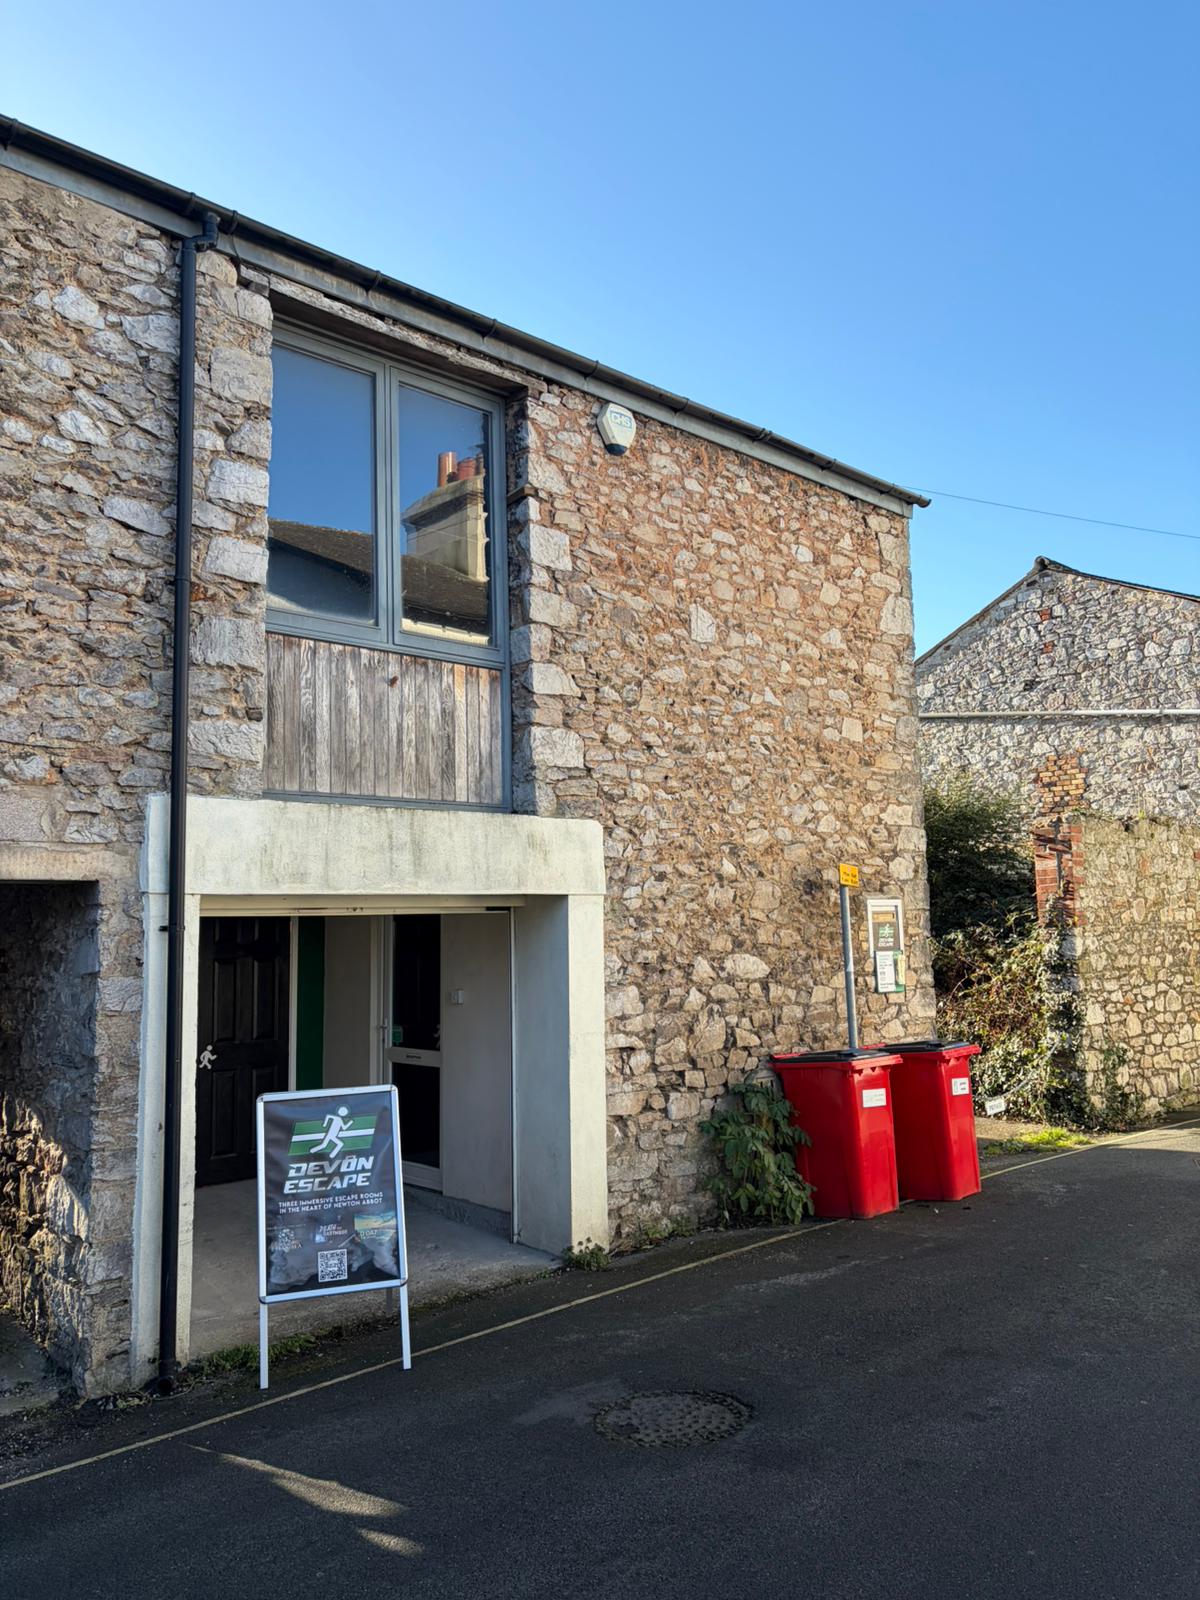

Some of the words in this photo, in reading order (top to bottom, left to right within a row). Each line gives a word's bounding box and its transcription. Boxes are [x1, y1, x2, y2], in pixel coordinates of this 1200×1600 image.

[288, 1156, 374, 1178] DEVON
[283, 1172, 372, 1194] ESCAPE
[299, 1197, 333, 1206] IMMERSIVE
[335, 1194, 358, 1202] ESCAPE
[360, 1192, 383, 1200] ROOMS
[301, 1204, 321, 1212] HEART
[333, 1200, 360, 1208] NEWTON
